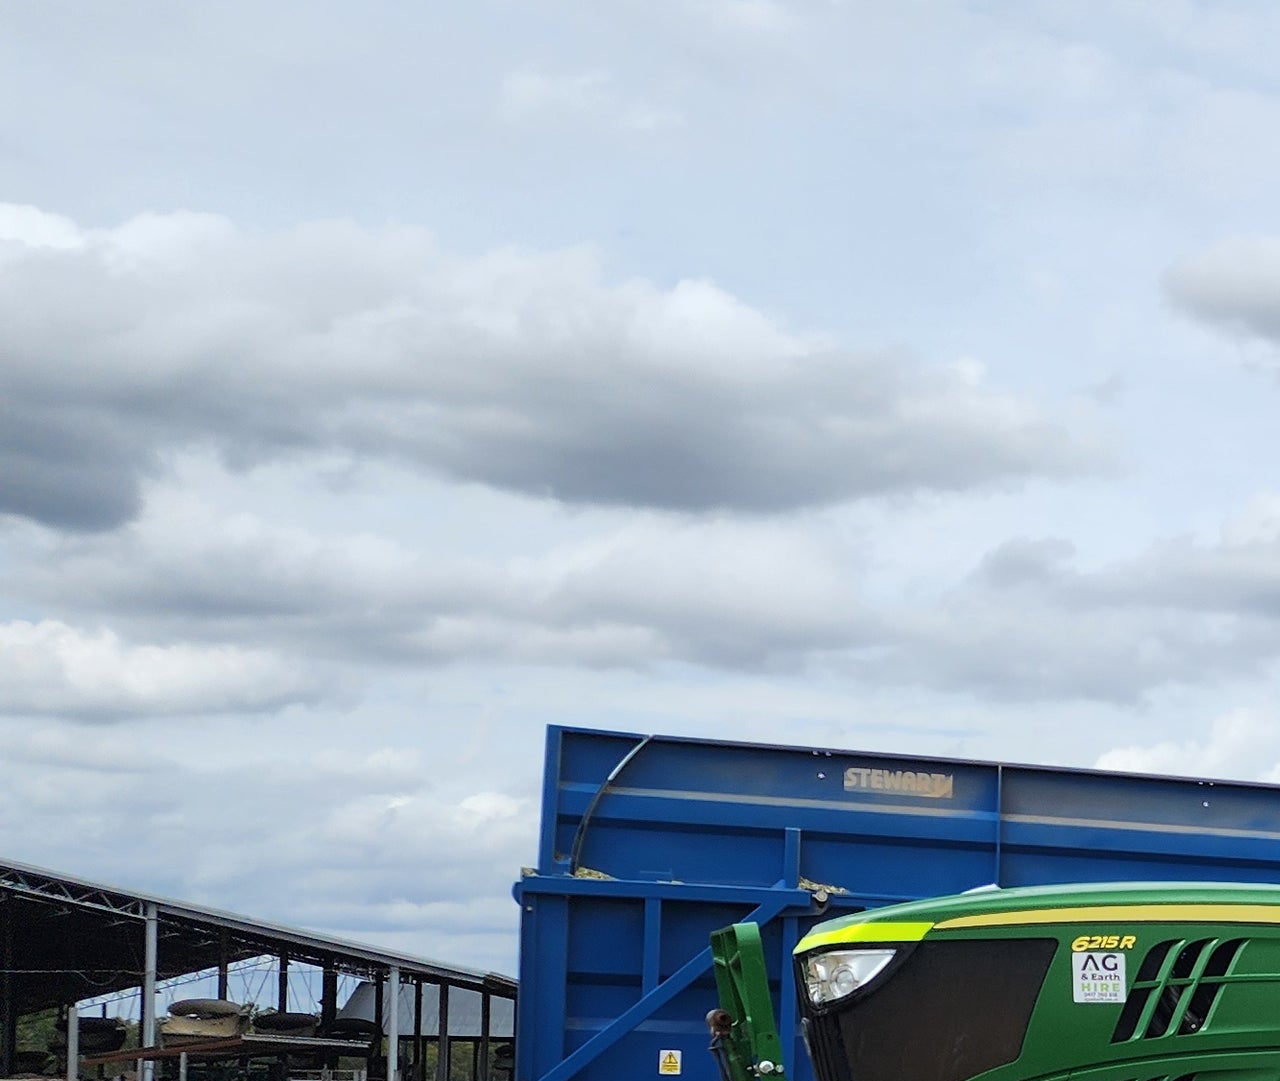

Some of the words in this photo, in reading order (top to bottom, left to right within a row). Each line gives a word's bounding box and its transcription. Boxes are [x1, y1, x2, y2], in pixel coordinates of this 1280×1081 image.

[844, 767, 953, 798] STEWART
[1081, 954, 1118, 971] AG
[1081, 973, 1088, 981] &
[1091, 973, 1120, 981] Earth
[1081, 983, 1120, 992] HIRE
